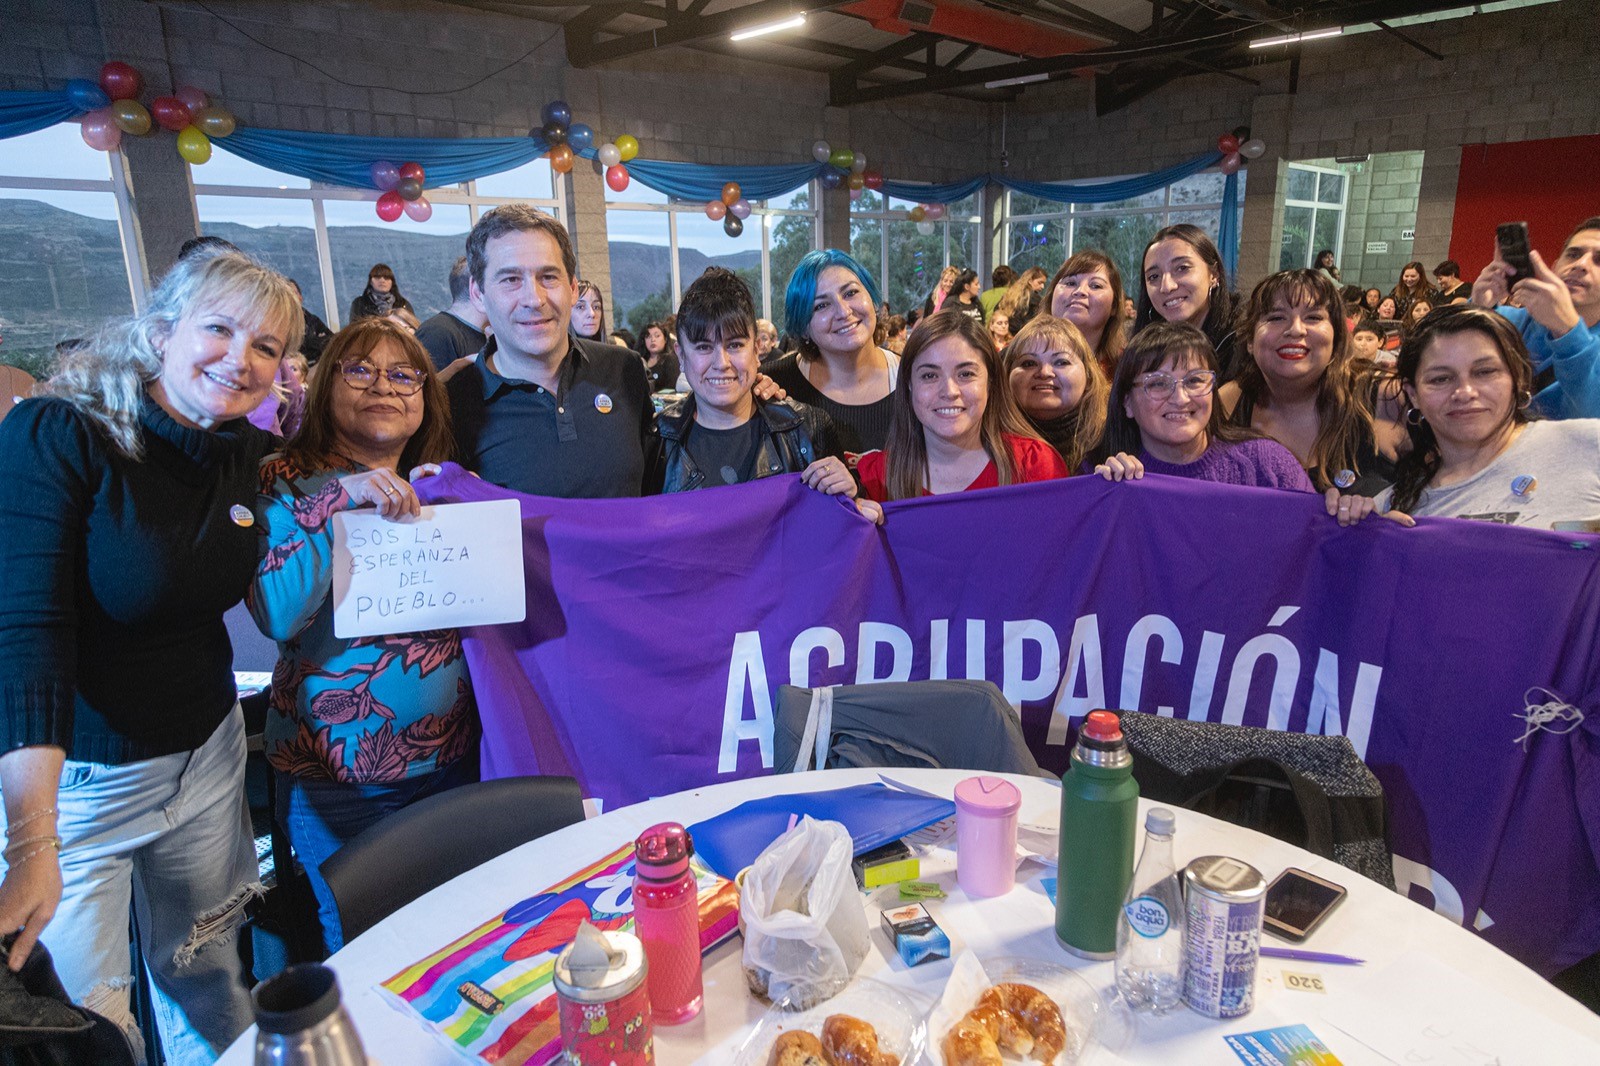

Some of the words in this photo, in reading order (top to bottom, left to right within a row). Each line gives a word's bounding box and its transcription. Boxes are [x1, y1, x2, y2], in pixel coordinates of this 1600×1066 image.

[350, 528, 399, 549] SOS
[415, 527, 443, 543] LA
[349, 546, 470, 575] ESPERANZA
[399, 570, 434, 588] DEL
[1135, 913, 1164, 925] aqua
[1288, 975, 1323, 990] 320
